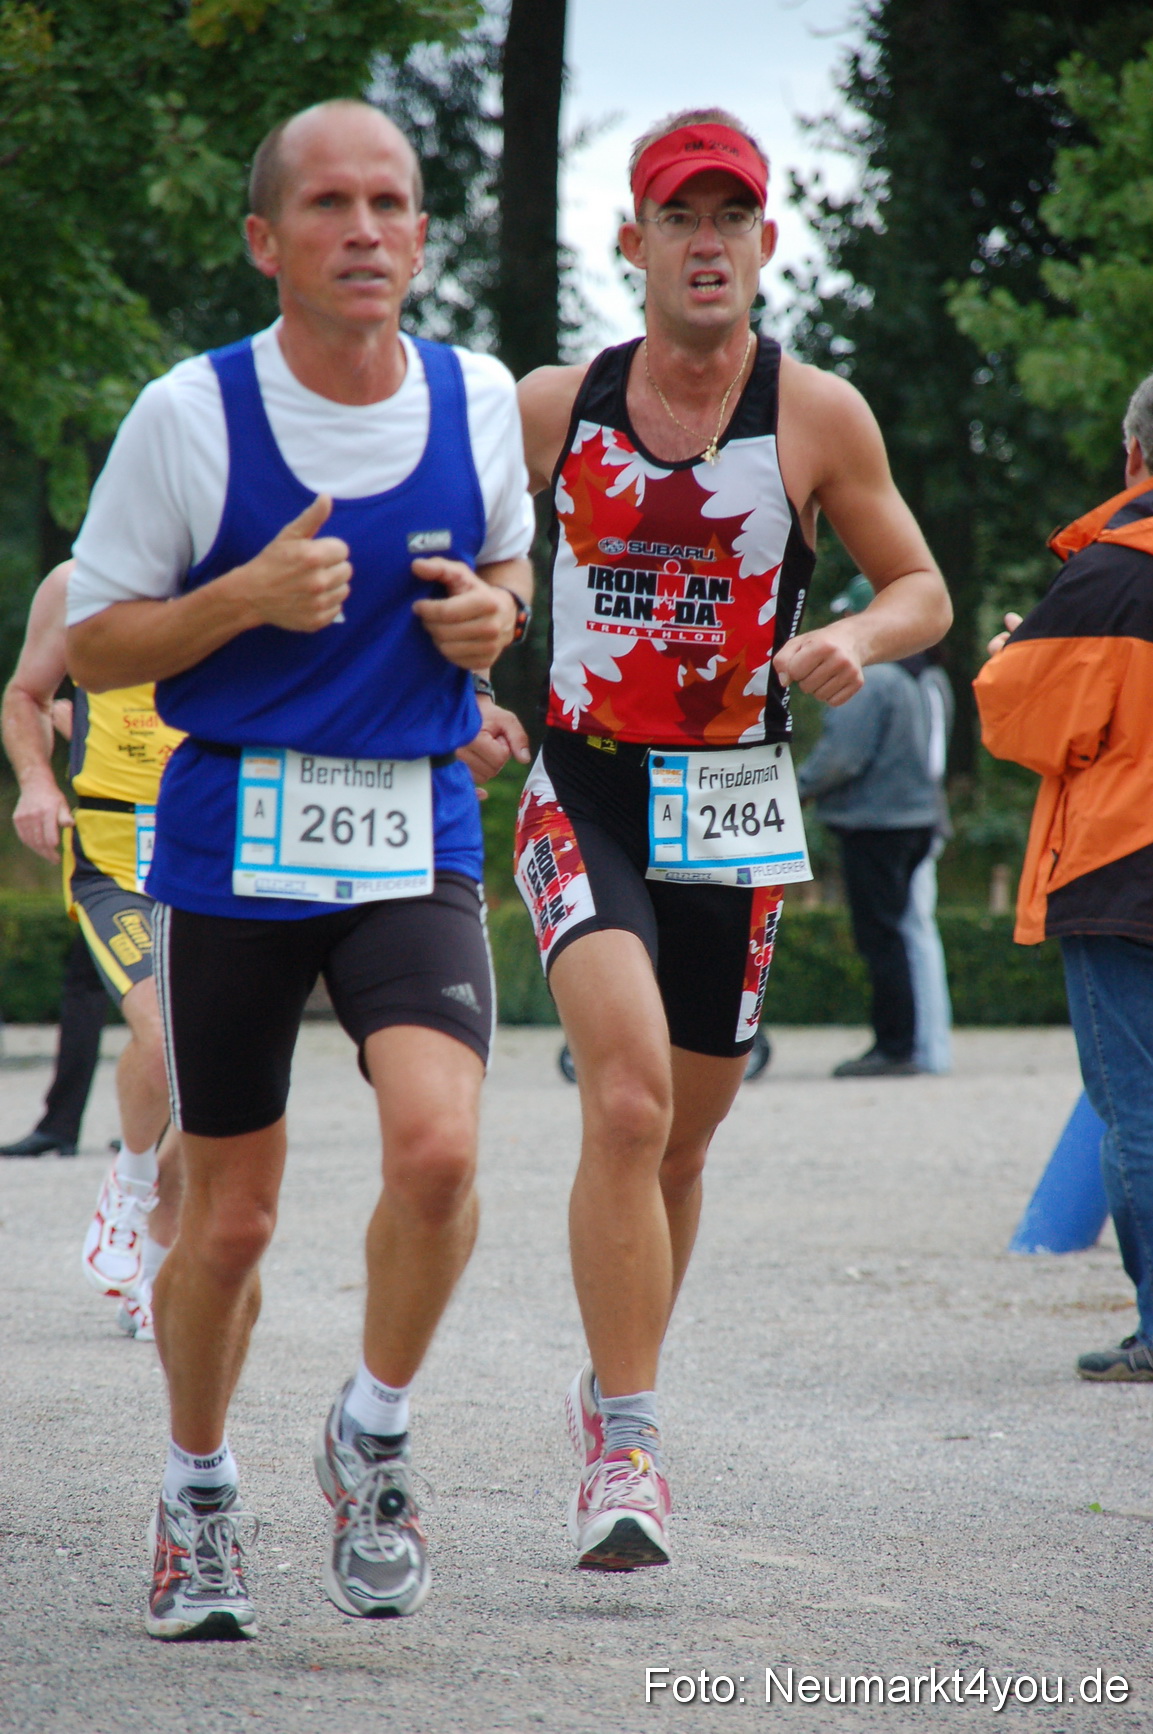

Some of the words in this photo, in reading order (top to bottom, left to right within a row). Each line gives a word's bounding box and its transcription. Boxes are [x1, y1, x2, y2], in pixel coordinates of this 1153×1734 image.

[628, 541, 716, 562] SUBARU
[587, 560, 734, 604] IRONMAN
[588, 622, 721, 643] TRIATHLON
[300, 756, 394, 790] Berthold
[698, 763, 778, 790] Friedeman
[255, 799, 265, 819] A
[662, 804, 672, 821] A
[700, 798, 784, 840] 2484
[300, 804, 409, 848] 2613
[752, 860, 807, 877] PFLEIDERER
[355, 877, 428, 893] PFLEIDERER
